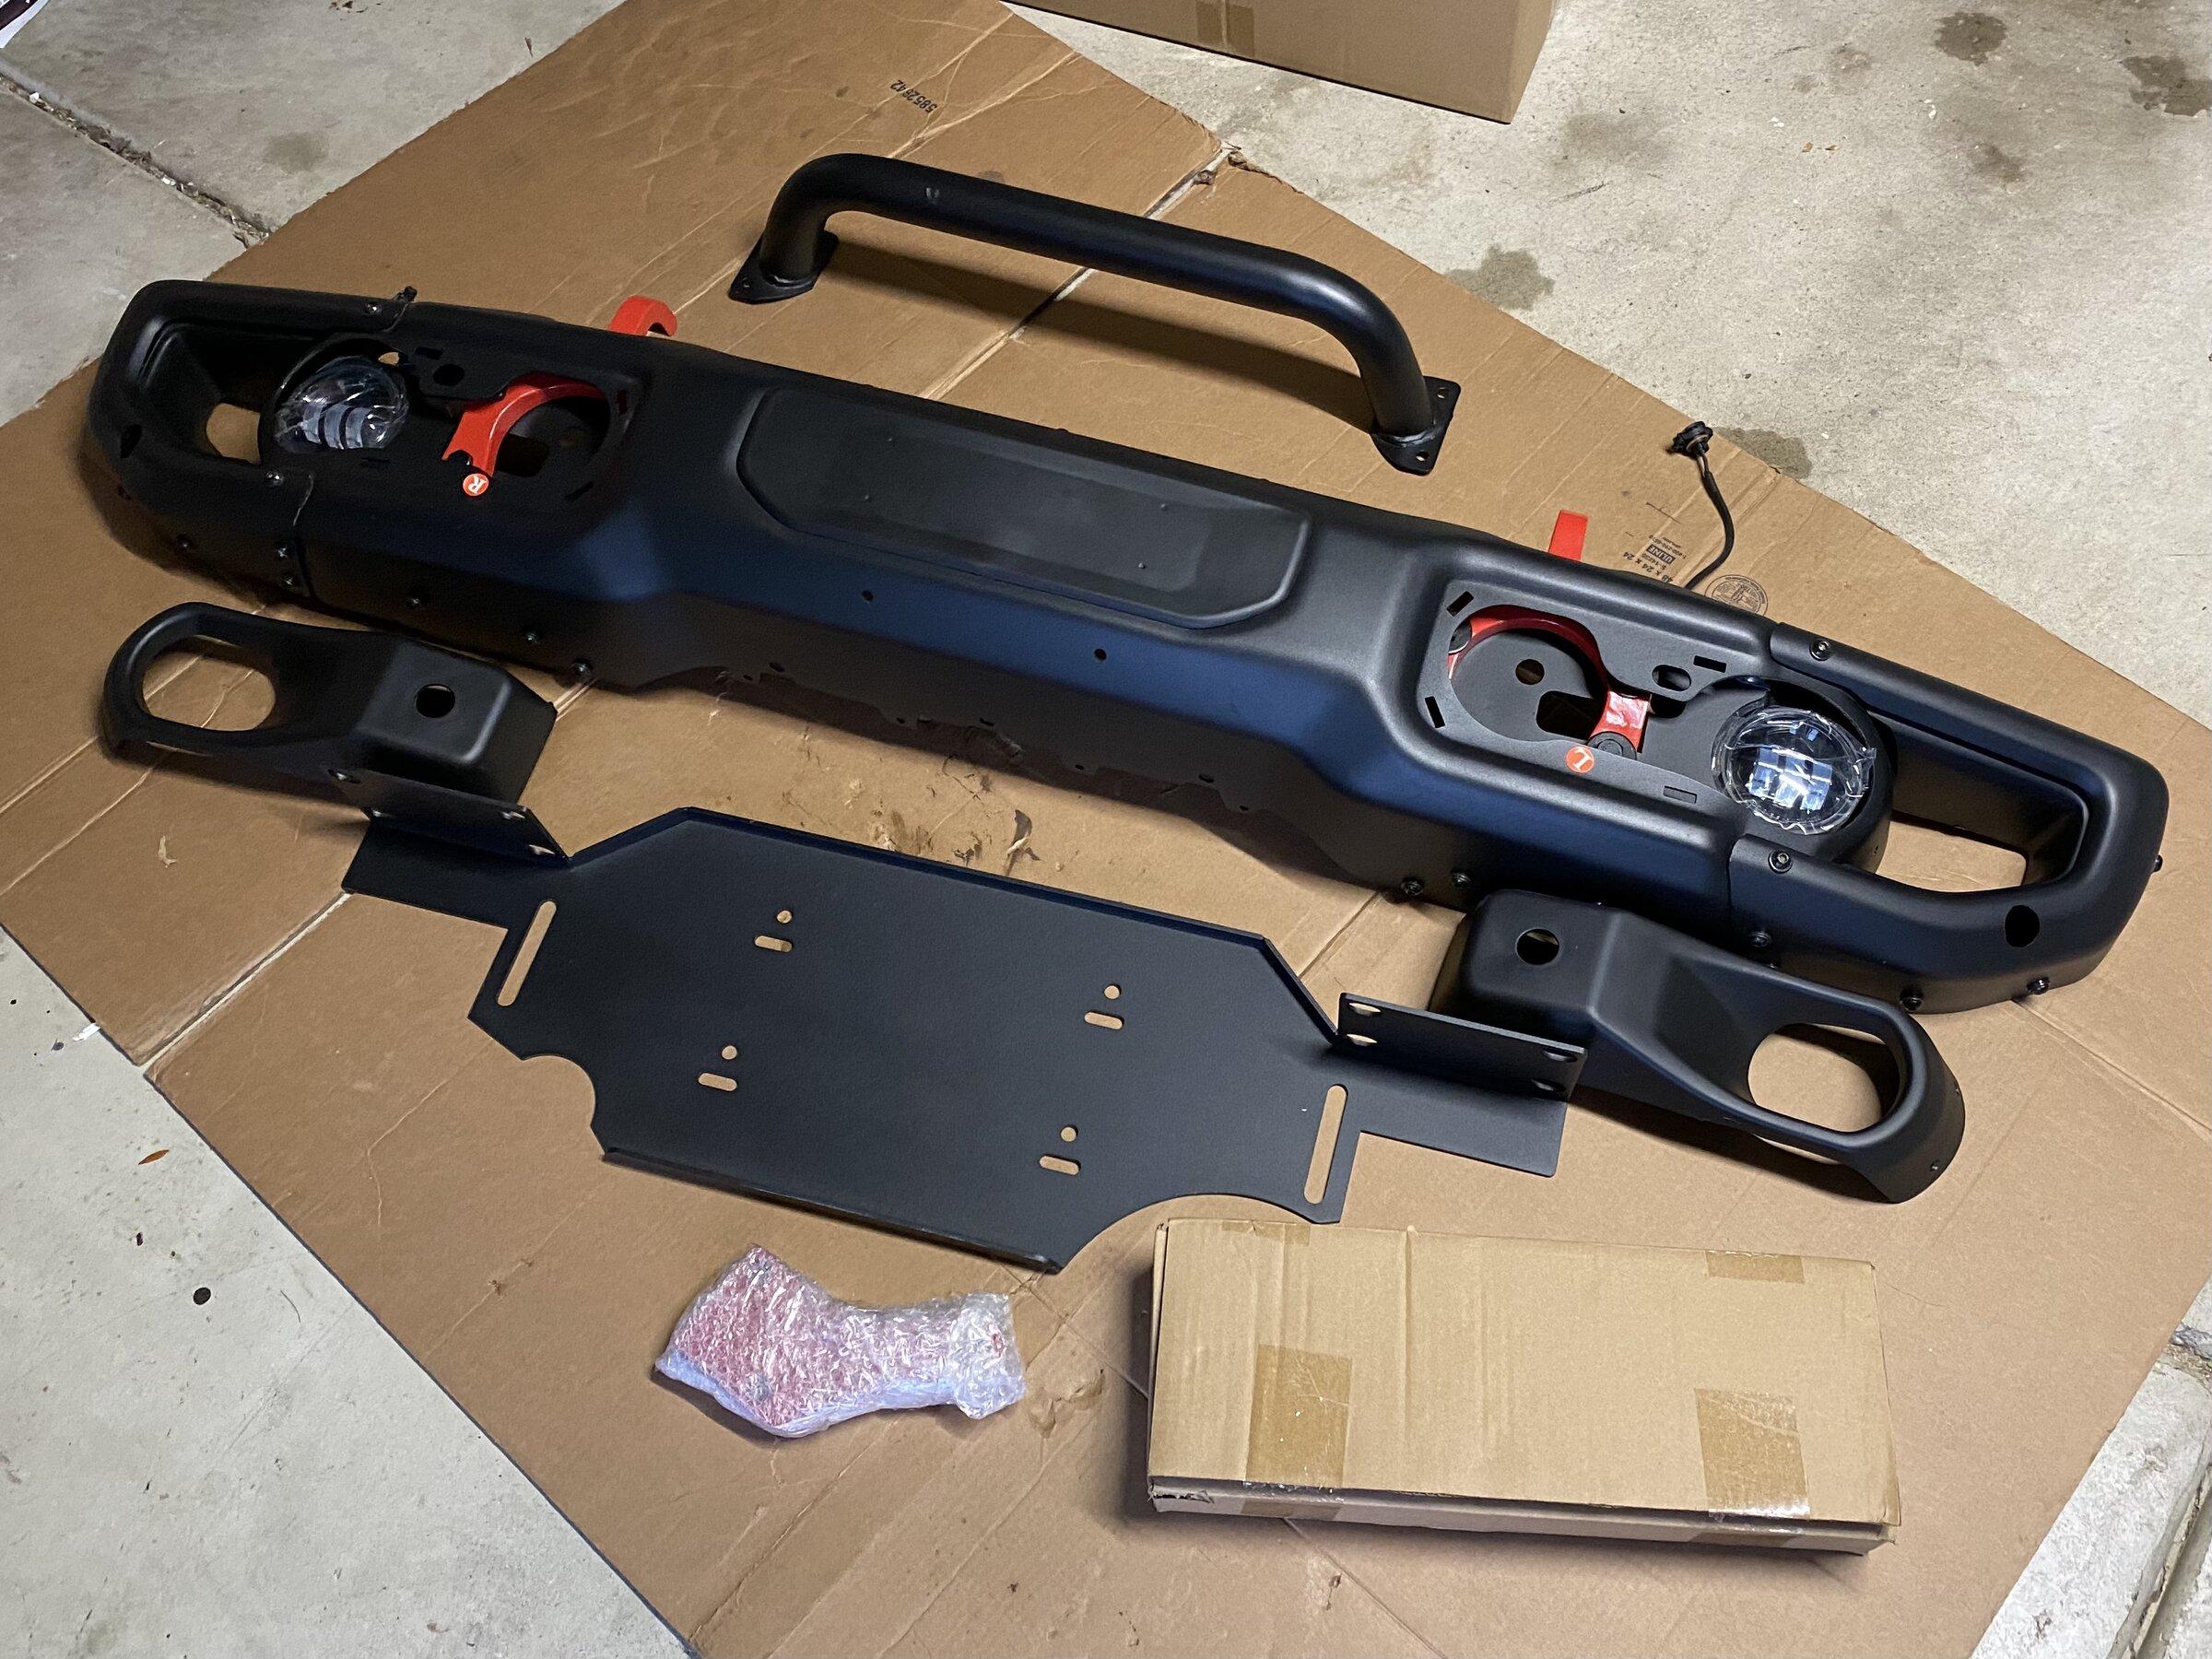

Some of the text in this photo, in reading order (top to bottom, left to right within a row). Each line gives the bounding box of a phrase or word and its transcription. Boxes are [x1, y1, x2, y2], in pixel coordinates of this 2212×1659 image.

[468, 475, 488, 495] R
[1622, 551, 1635, 560] 24
[1648, 545, 1673, 564] ULINE
[1641, 563, 1655, 572] 24
[1661, 574, 1674, 583] 48
[1572, 747, 1592, 771] L
